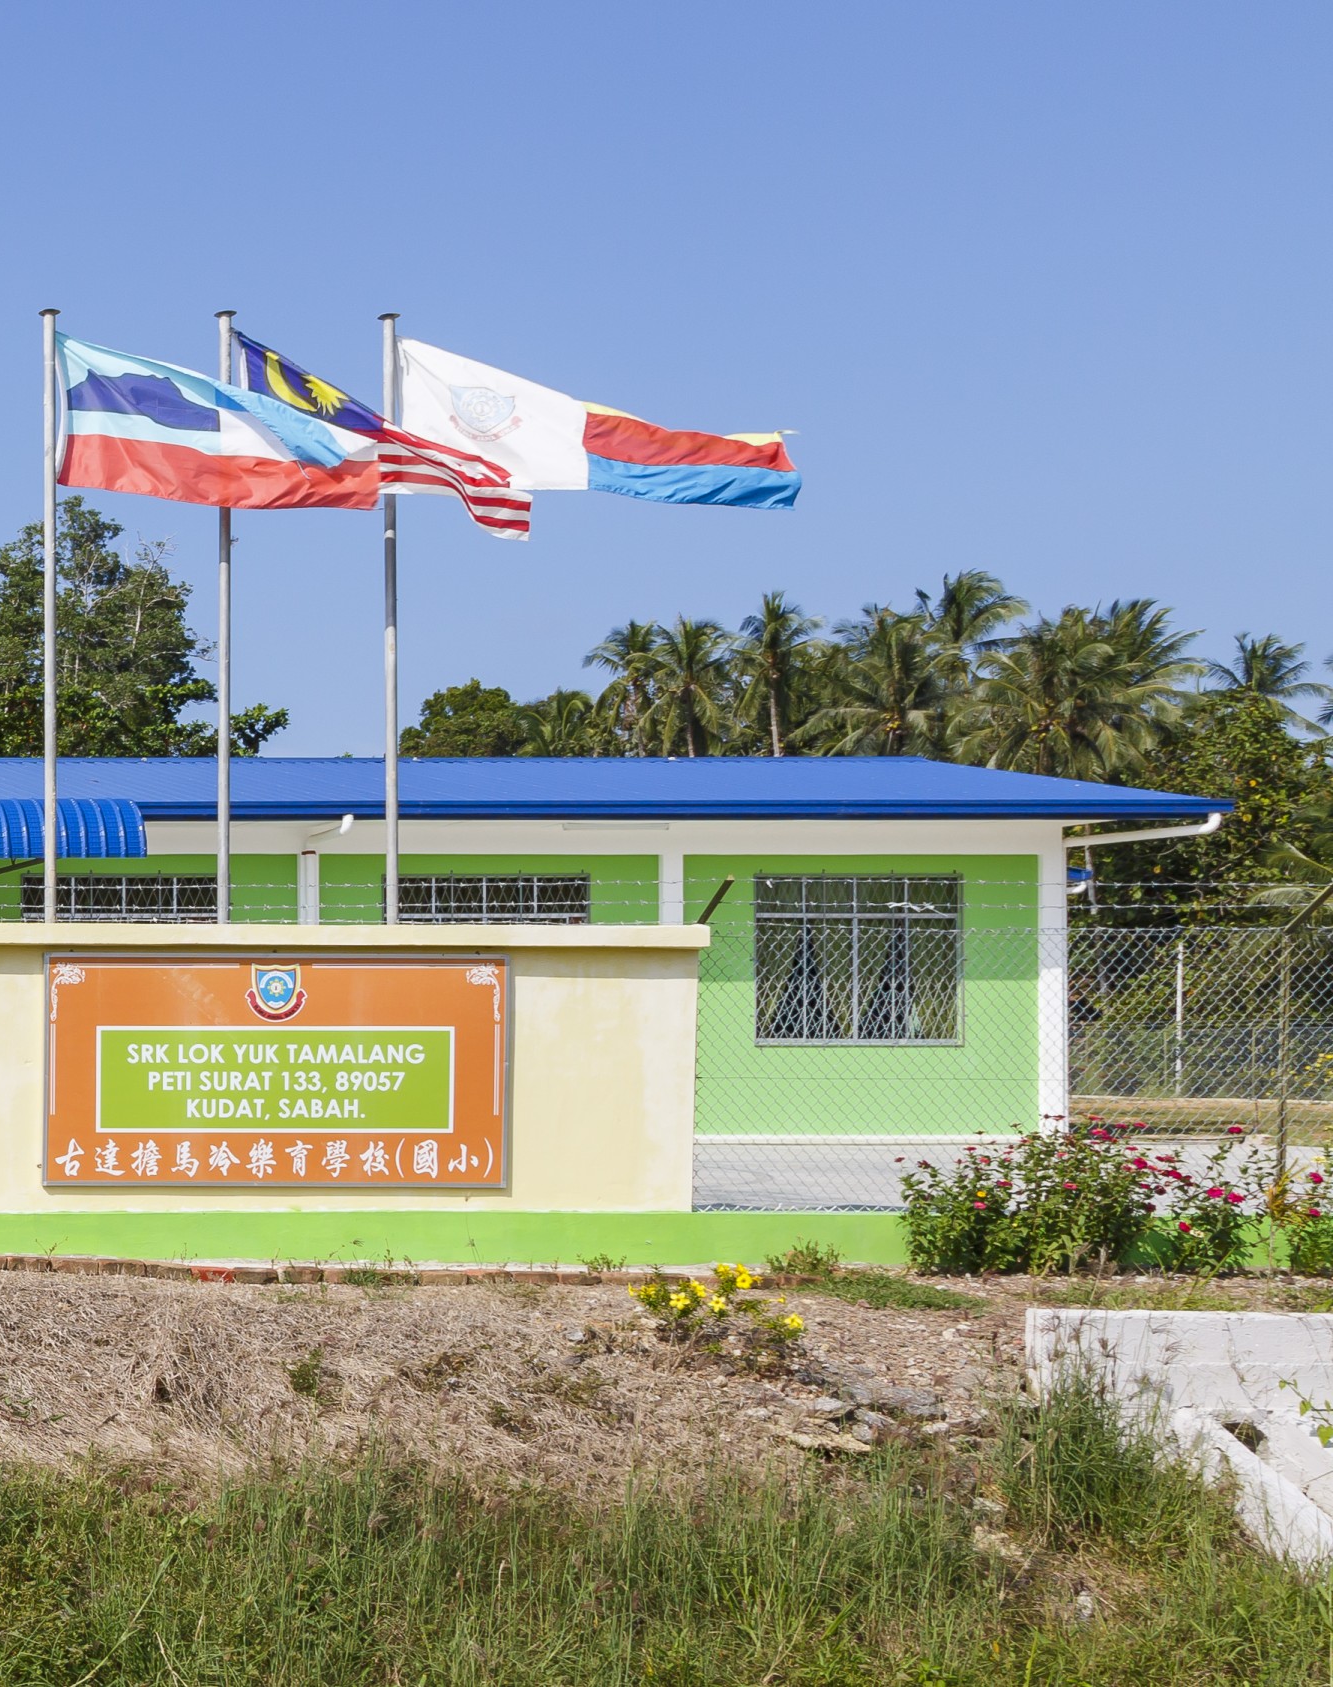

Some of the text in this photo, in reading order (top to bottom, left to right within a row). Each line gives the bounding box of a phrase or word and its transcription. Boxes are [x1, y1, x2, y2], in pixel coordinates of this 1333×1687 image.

[126, 1043, 426, 1065] SRK LOK YUK TAMALANG
[148, 1070, 406, 1094] PETI SURAT 133, 89057
[186, 1098, 366, 1121] KUDAT, SABAH.
